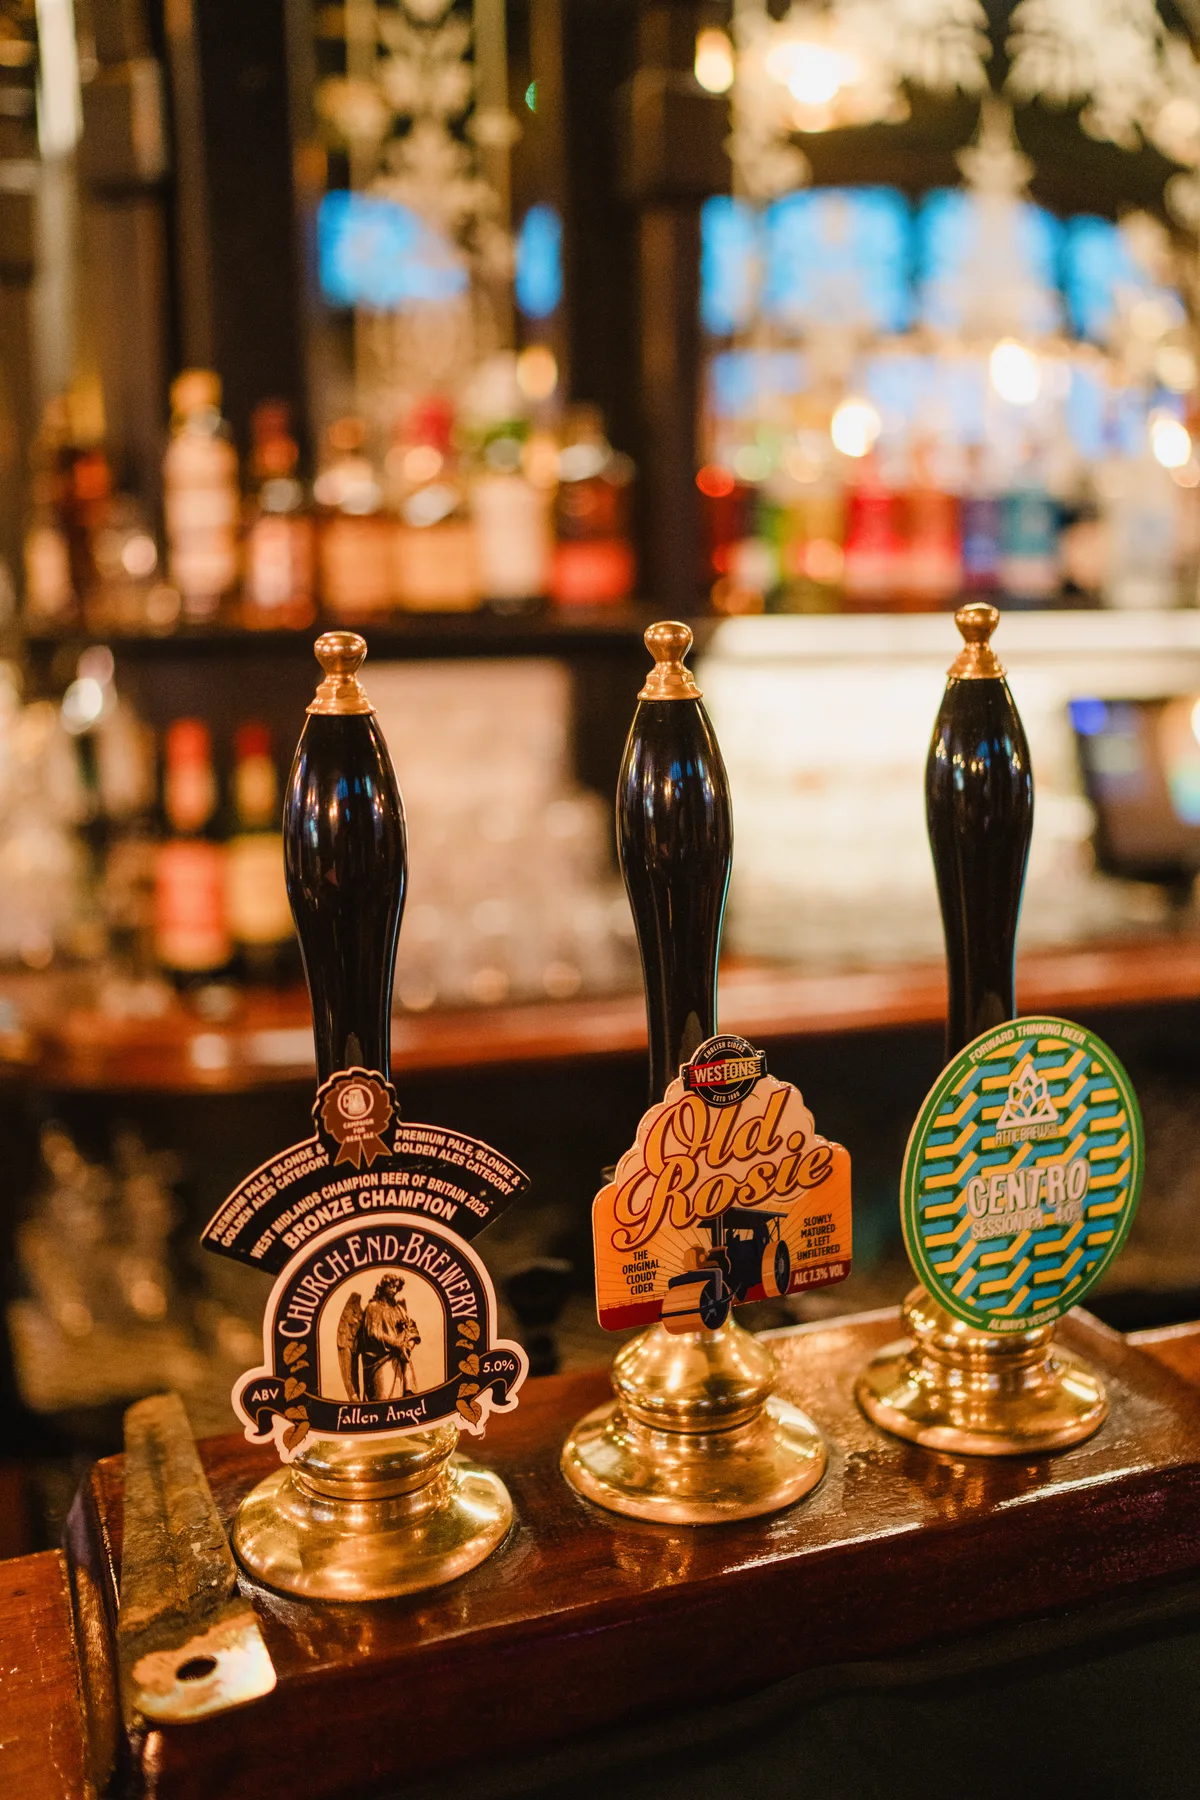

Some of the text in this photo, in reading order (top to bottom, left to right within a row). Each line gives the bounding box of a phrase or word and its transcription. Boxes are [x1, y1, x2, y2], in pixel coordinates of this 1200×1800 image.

[703, 1041, 746, 1059] ENGLISH CIDERS
[969, 1023, 1086, 1064] FORWARD THINKING BEER
[694, 1061, 756, 1083] WESTONS
[343, 1118, 375, 1130] CAMPAIGN
[643, 1085, 791, 1177] Old
[345, 1135, 362, 1143] REAL
[395, 1129, 521, 1186] PREMIUM PALE, BLONDE &
[393, 1142, 515, 1196] GOLDEN ALES CATEGORY
[209, 1143, 325, 1242] PREMIUM PALE, BLONDE &
[611, 1131, 833, 1251] Rosie
[967, 1158, 1090, 1218] CENTRO
[221, 1153, 330, 1248] GOLDEN ALES CATEGORY
[250, 1172, 490, 1259] WEST MIDLANDS CHAMPION BEER OF BRITAIN 2023
[281, 1189, 458, 1250] BRONZE CHAMPION
[803, 1213, 832, 1227] SLOWLY
[801, 1224, 836, 1238] MATURED
[972, 1214, 1024, 1240] SESSION
[797, 1244, 840, 1260] UNFILTERED
[807, 1235, 830, 1248] & LEFT
[633, 1250, 648, 1261] THE
[622, 1259, 660, 1275] ORIGINAL
[626, 1270, 657, 1285] CLOUDY
[794, 1270, 809, 1286] ALC
[829, 1264, 844, 1278] VOL
[630, 1282, 654, 1295] CIDER
[482, 1359, 515, 1373] 5.0%
[251, 1387, 280, 1402] ABV
[385, 1399, 428, 1425] Angel
